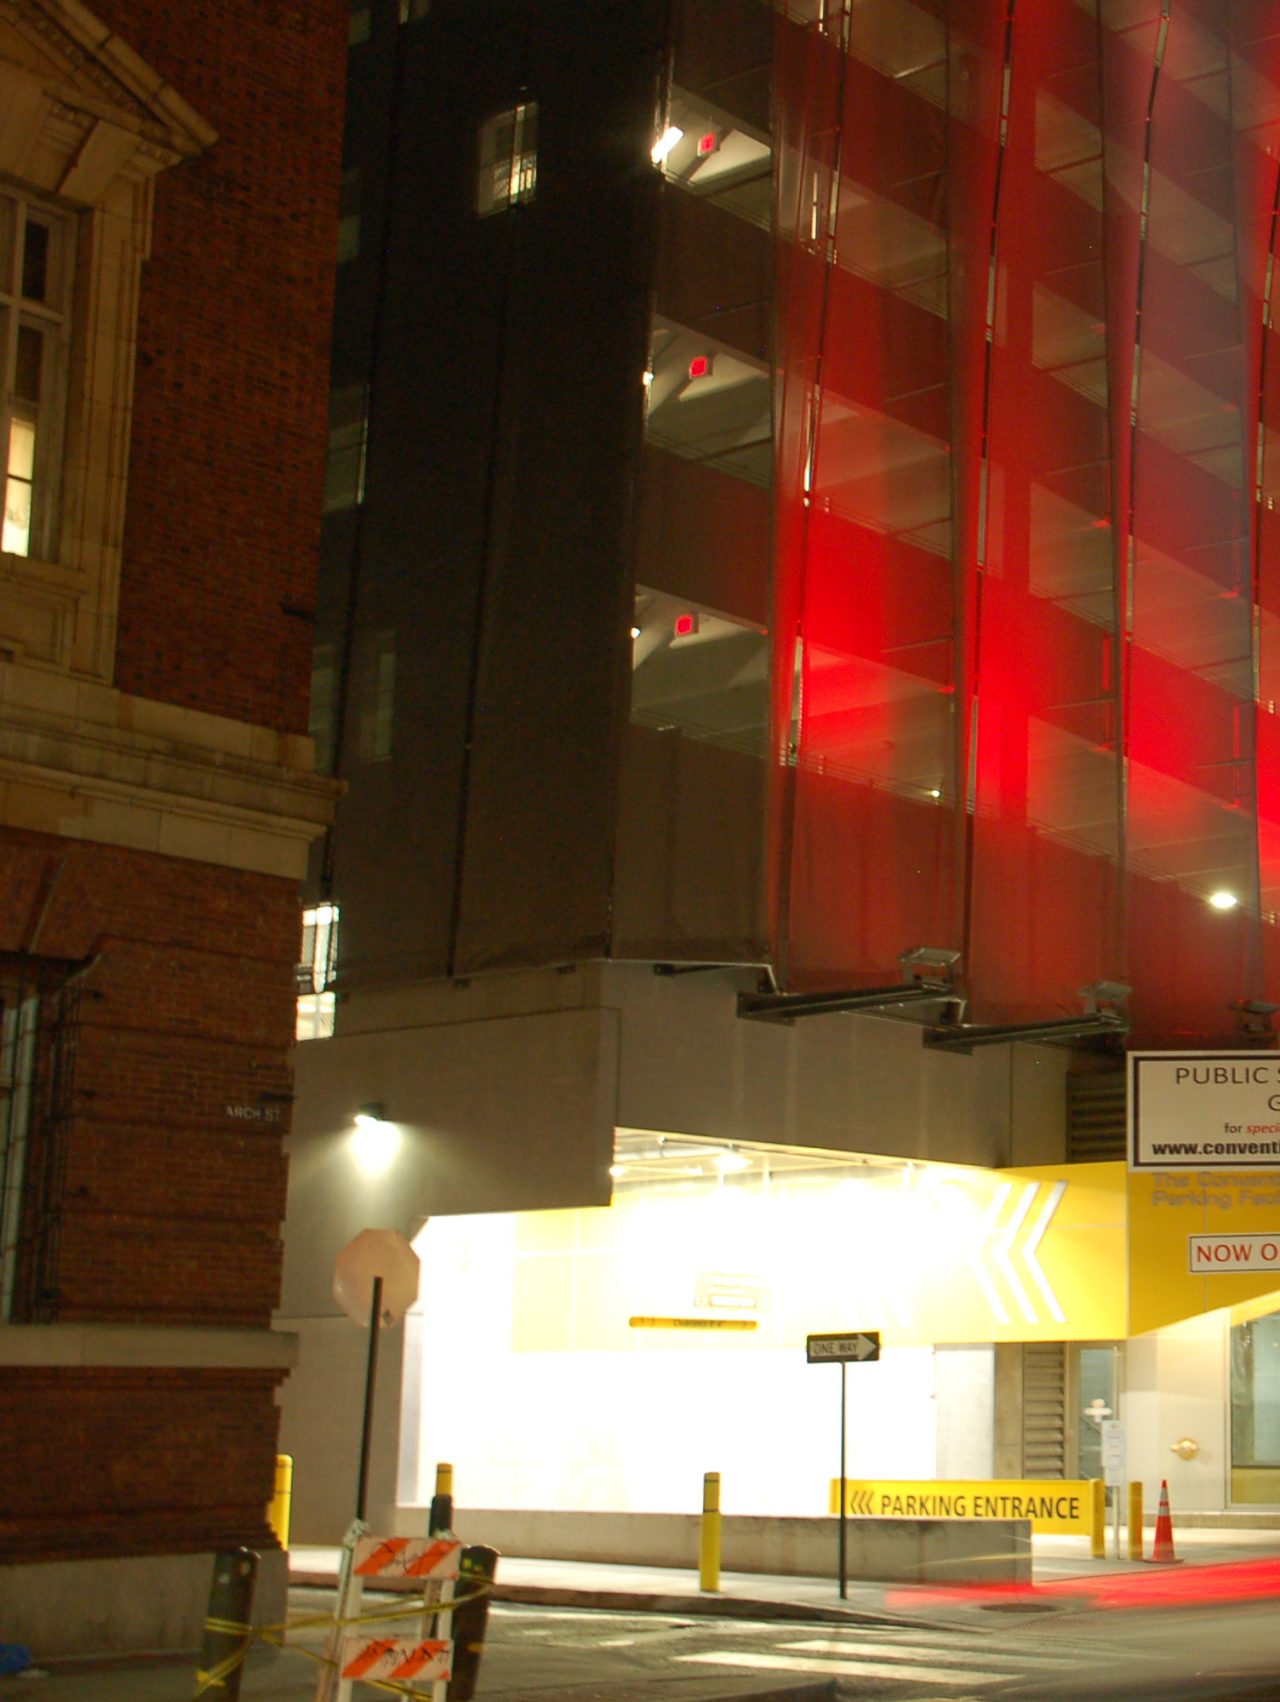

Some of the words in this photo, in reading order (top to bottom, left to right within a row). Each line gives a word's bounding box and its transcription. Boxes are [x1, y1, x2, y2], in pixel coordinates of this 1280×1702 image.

[1175, 1066, 1270, 1085] PUBLIC
[1224, 1121, 1243, 1134] for
[1152, 1190, 1232, 1209] Parking
[1197, 1243, 1253, 1263] NOW
[813, 1342, 834, 1355] ONE
[839, 1341, 858, 1354] WAY
[880, 1494, 967, 1517] PARKING
[973, 1495, 1080, 1519] ENTRANCE
